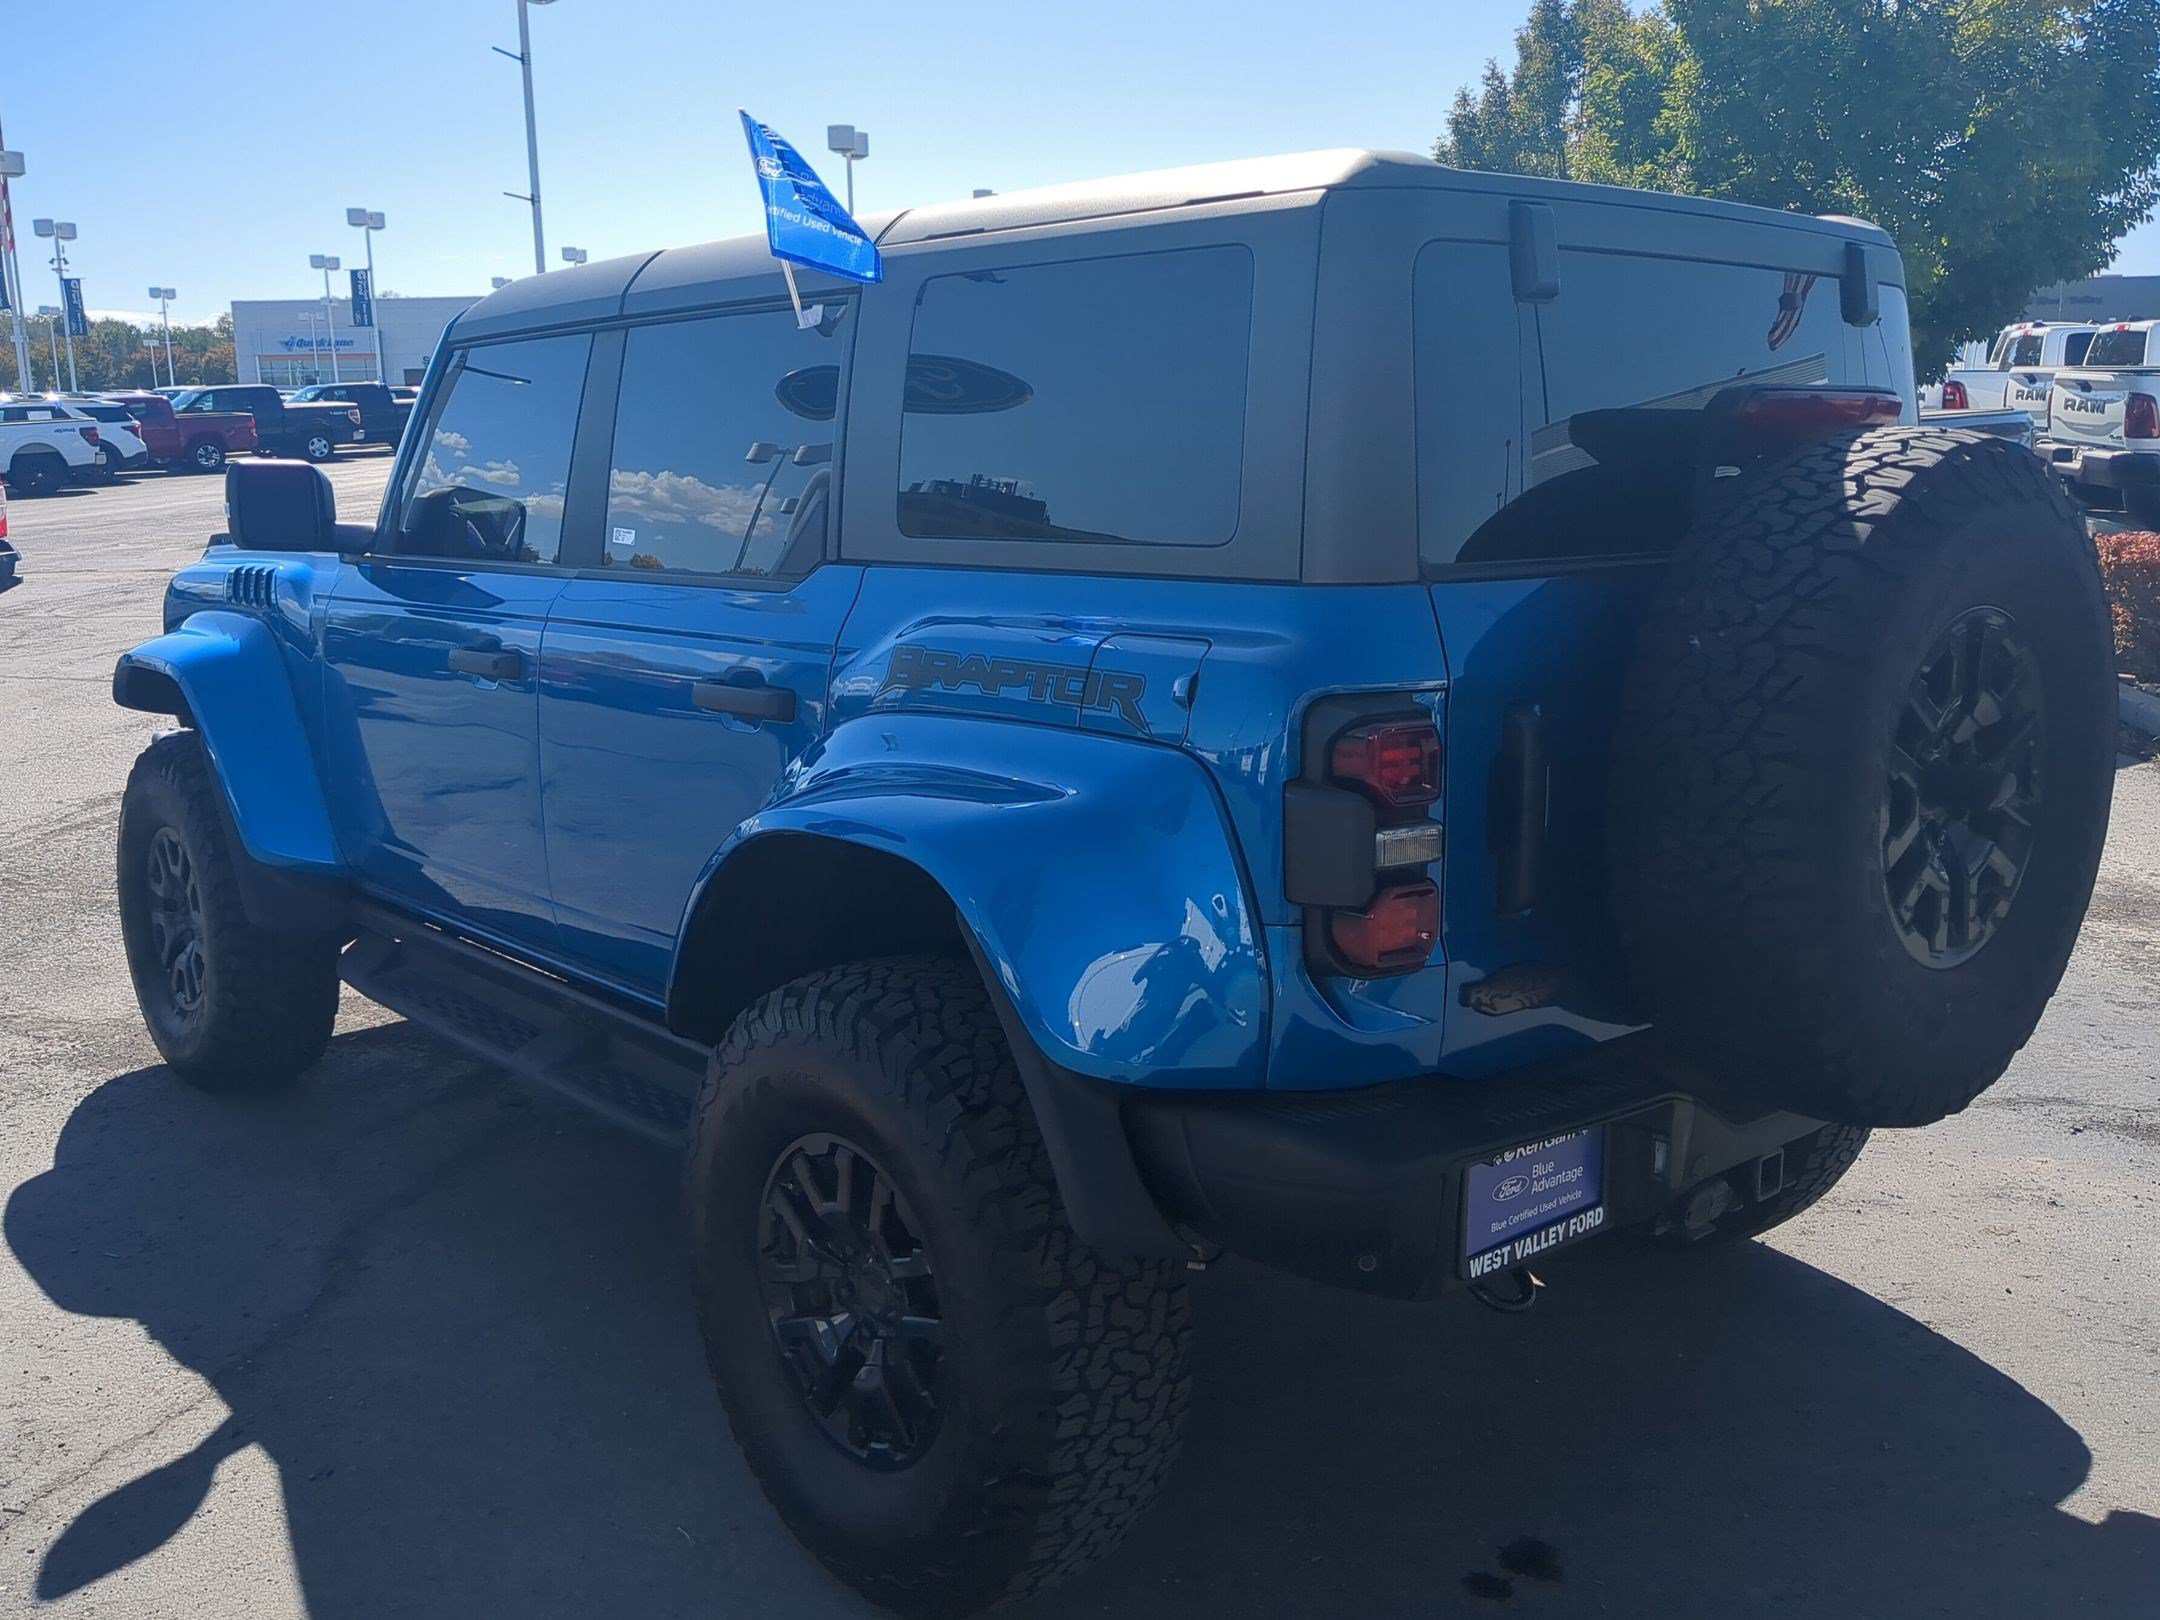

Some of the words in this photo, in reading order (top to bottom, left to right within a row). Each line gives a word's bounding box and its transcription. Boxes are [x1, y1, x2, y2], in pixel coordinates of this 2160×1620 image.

[759, 159, 784, 178] Ford
[803, 215, 831, 233] Used
[831, 224, 863, 246] Vehicle
[2015, 389, 2047, 401] RAM
[2063, 397, 2106, 415] RAM
[1532, 1161, 1555, 1178] Blue
[1499, 1179, 1523, 1198] Ford
[1531, 1166, 1584, 1195] Advantage
[1491, 1220, 1507, 1233] Blue
[1508, 1205, 1538, 1225] Certified
[1539, 1198, 1557, 1213] Used
[1559, 1189, 1583, 1206] Vehicle
[1469, 1244, 1512, 1279] WEST
[1514, 1222, 1567, 1260] VALLEY
[1569, 1206, 1604, 1238] FORD
